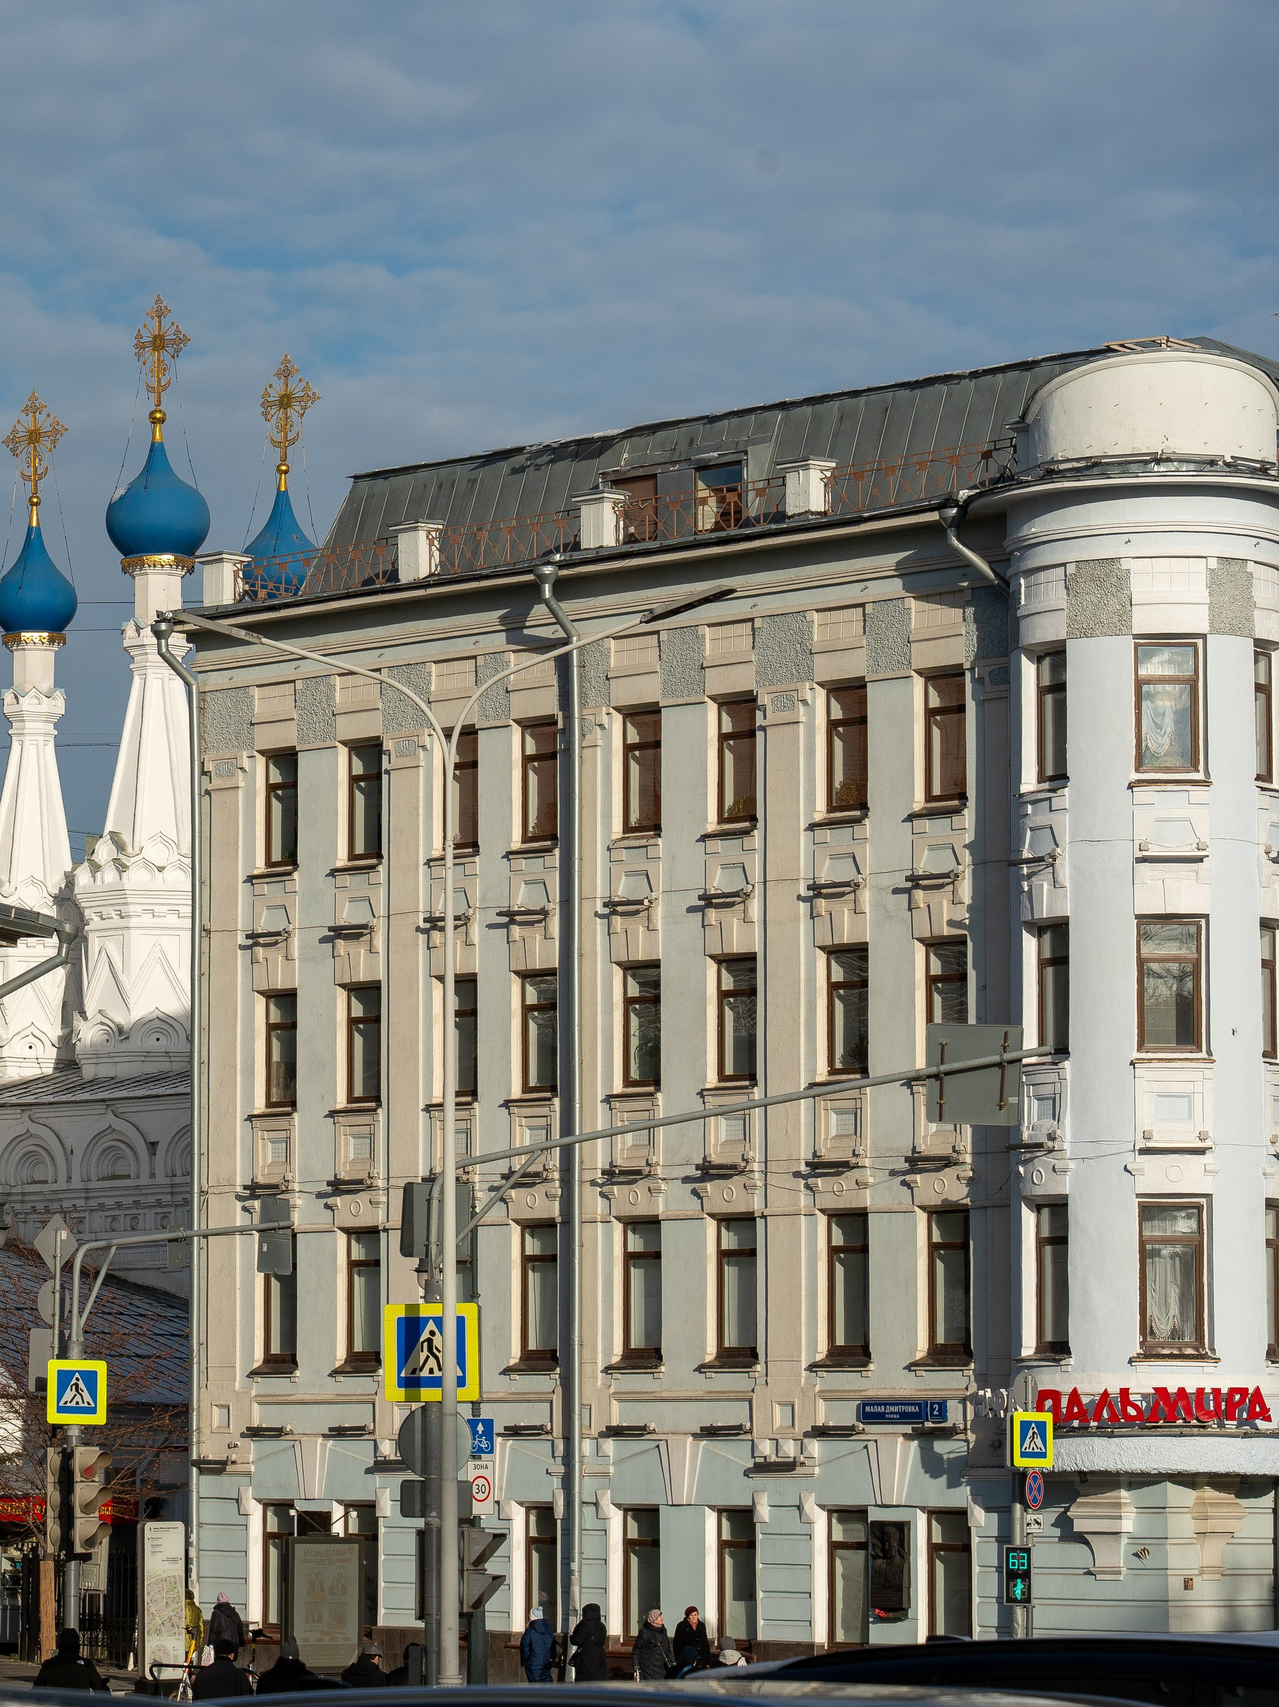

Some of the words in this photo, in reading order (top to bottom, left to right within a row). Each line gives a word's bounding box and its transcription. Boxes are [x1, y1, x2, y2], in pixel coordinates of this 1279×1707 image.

[885, 1405, 919, 1413] ДМИТРОВКА
[933, 1404, 939, 1414] 2
[475, 1483, 486, 1494] 30
[1009, 1552, 1027, 1569] 63
